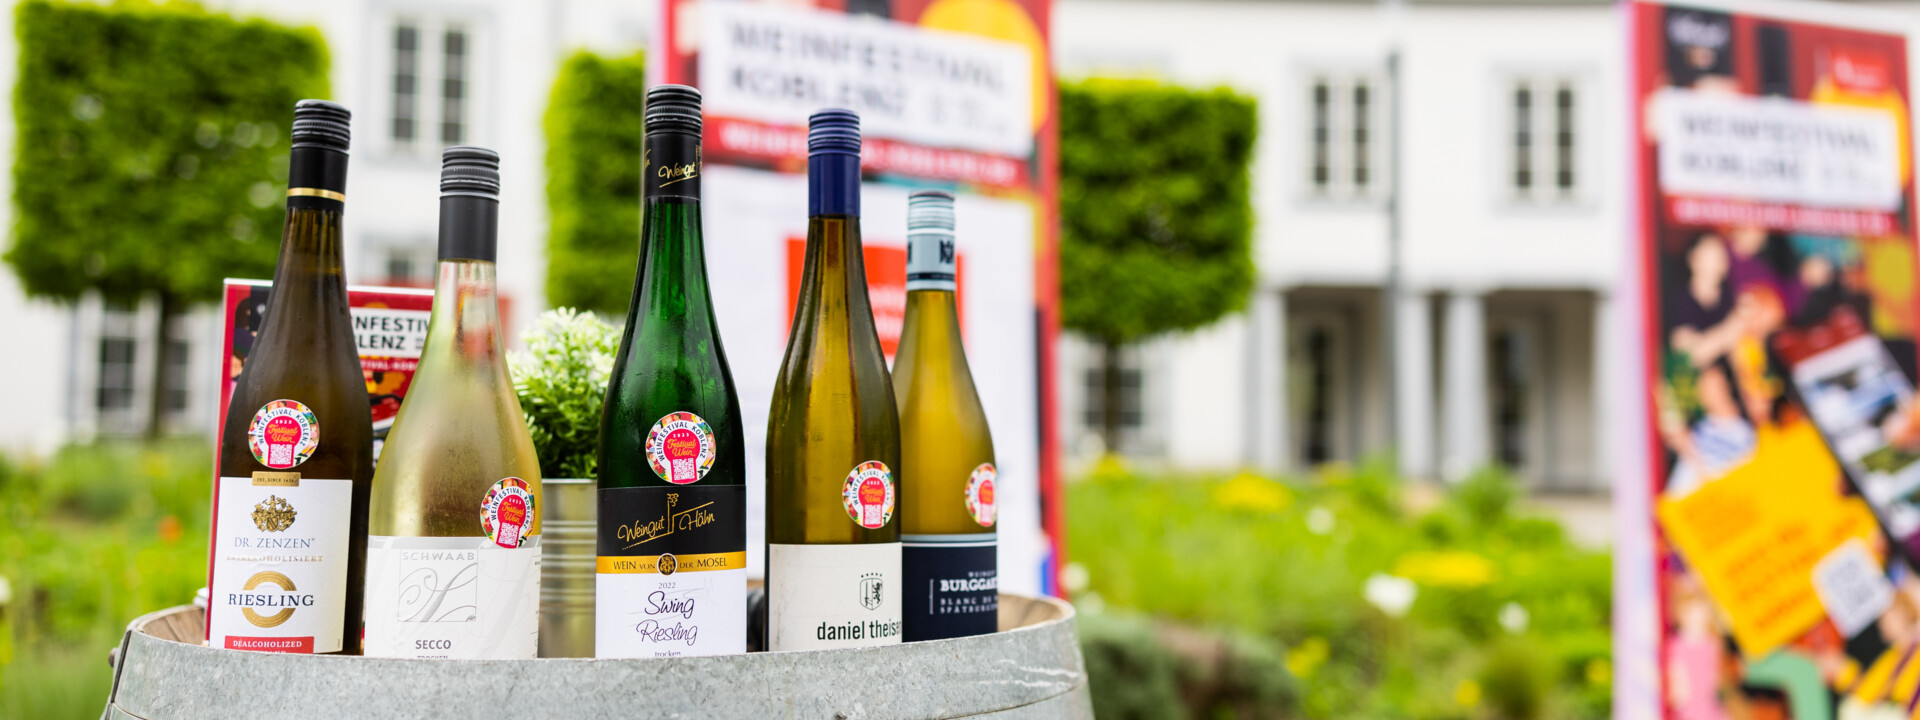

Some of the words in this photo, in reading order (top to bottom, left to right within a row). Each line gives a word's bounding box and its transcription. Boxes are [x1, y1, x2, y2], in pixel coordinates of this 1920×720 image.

[658, 161, 696, 179] Weingut
[258, 408, 292, 445] WEINFESTIVAL
[295, 414, 310, 447] KOBLENZ
[267, 424, 299, 434] Festival
[271, 433, 296, 444] Wein
[656, 421, 688, 462] WEINFESTIVAL
[691, 425, 708, 459] KOBLENZ
[667, 438, 697, 449] Festival
[671, 448, 696, 457] Wein
[490, 487, 523, 521] WEINFESTIVAL
[501, 501, 525, 518] Festival
[617, 515, 665, 542] Weingut
[234, 537, 253, 548] DR.
[402, 552, 475, 561] SCHWAAB
[613, 561, 637, 570] WEIN
[697, 557, 728, 568] MOSEL
[228, 593, 315, 607] RIESLING
[644, 590, 695, 620] Swing
[636, 618, 698, 647] Riesling
[817, 621, 865, 641] daniel
[233, 640, 302, 648] DEALCOHOLIZED
[415, 639, 452, 650] SECCO
